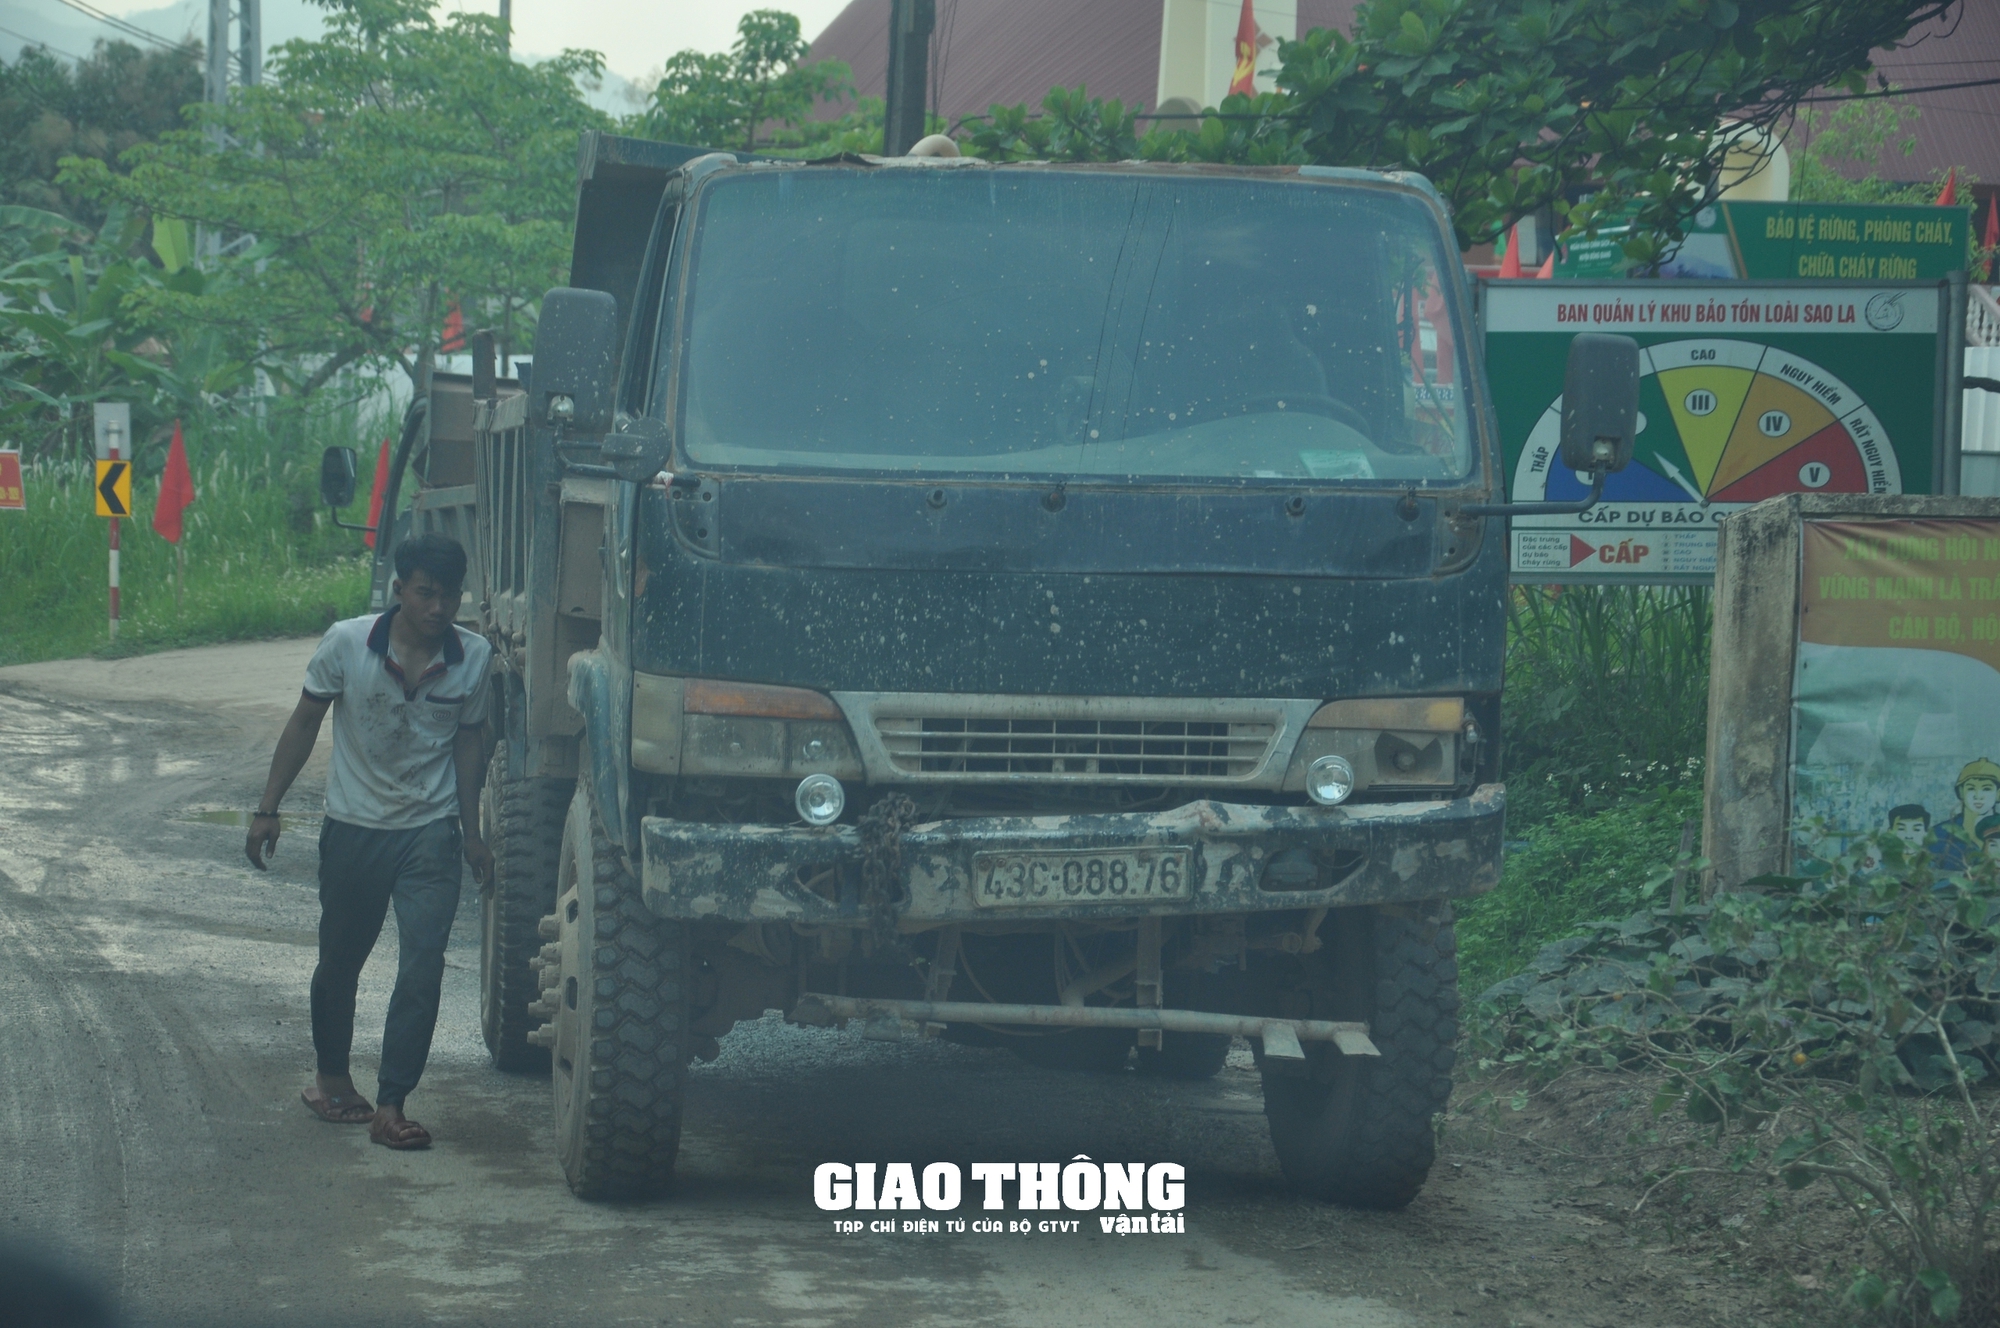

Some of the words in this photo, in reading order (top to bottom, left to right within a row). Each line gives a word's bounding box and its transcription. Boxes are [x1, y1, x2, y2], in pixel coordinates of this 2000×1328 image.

[1766, 211, 1794, 239] BẢO
[1799, 214, 1815, 245] VỆ
[1819, 214, 1860, 244] RỪNG,
[1864, 216, 1911, 243] PHÒNG
[1915, 217, 1953, 246] CHÁY,
[1799, 252, 1835, 277] CHỮA
[1839, 252, 1875, 278] CHÁY
[1879, 254, 1917, 279] RỪNG
[1557, 303, 1588, 322] BAN
[1593, 298, 1634, 324] QUẢN
[1639, 299, 1656, 323] LÝ
[1661, 303, 1691, 322] KHU
[1696, 298, 1726, 323] BẢO
[1731, 298, 1760, 323] TỒN
[1765, 299, 1798, 323] LOÀI
[1803, 304, 1833, 323] SAO
[1837, 304, 1855, 323] LA
[1690, 349, 1716, 360] CAO
[1780, 363, 1814, 386] NGUY
[1691, 394, 1710, 411] III
[1765, 416, 1783, 432] IV
[1849, 417, 1873, 439] RẤT
[1861, 439, 1883, 467] NGUY
[1531, 446, 1550, 473] THẤP
[1809, 467, 1821, 483] V
[1578, 505, 1621, 523] CẤP
[1627, 509, 1655, 527] DỰ
[1661, 506, 1704, 523] BÁO
[1598, 538, 1649, 564] CẤP
[1886, 535, 1940, 566] DỰNG
[1945, 533, 1978, 565] HỘI
[1819, 572, 1870, 600] VỮNG
[1876, 577, 1933, 605] MẠNH
[1939, 572, 1963, 600] LÀ
[1889, 612, 1929, 639] CÁN
[1935, 612, 1966, 644] BỘ,
[983, 856, 1181, 900] 43C-088.76
